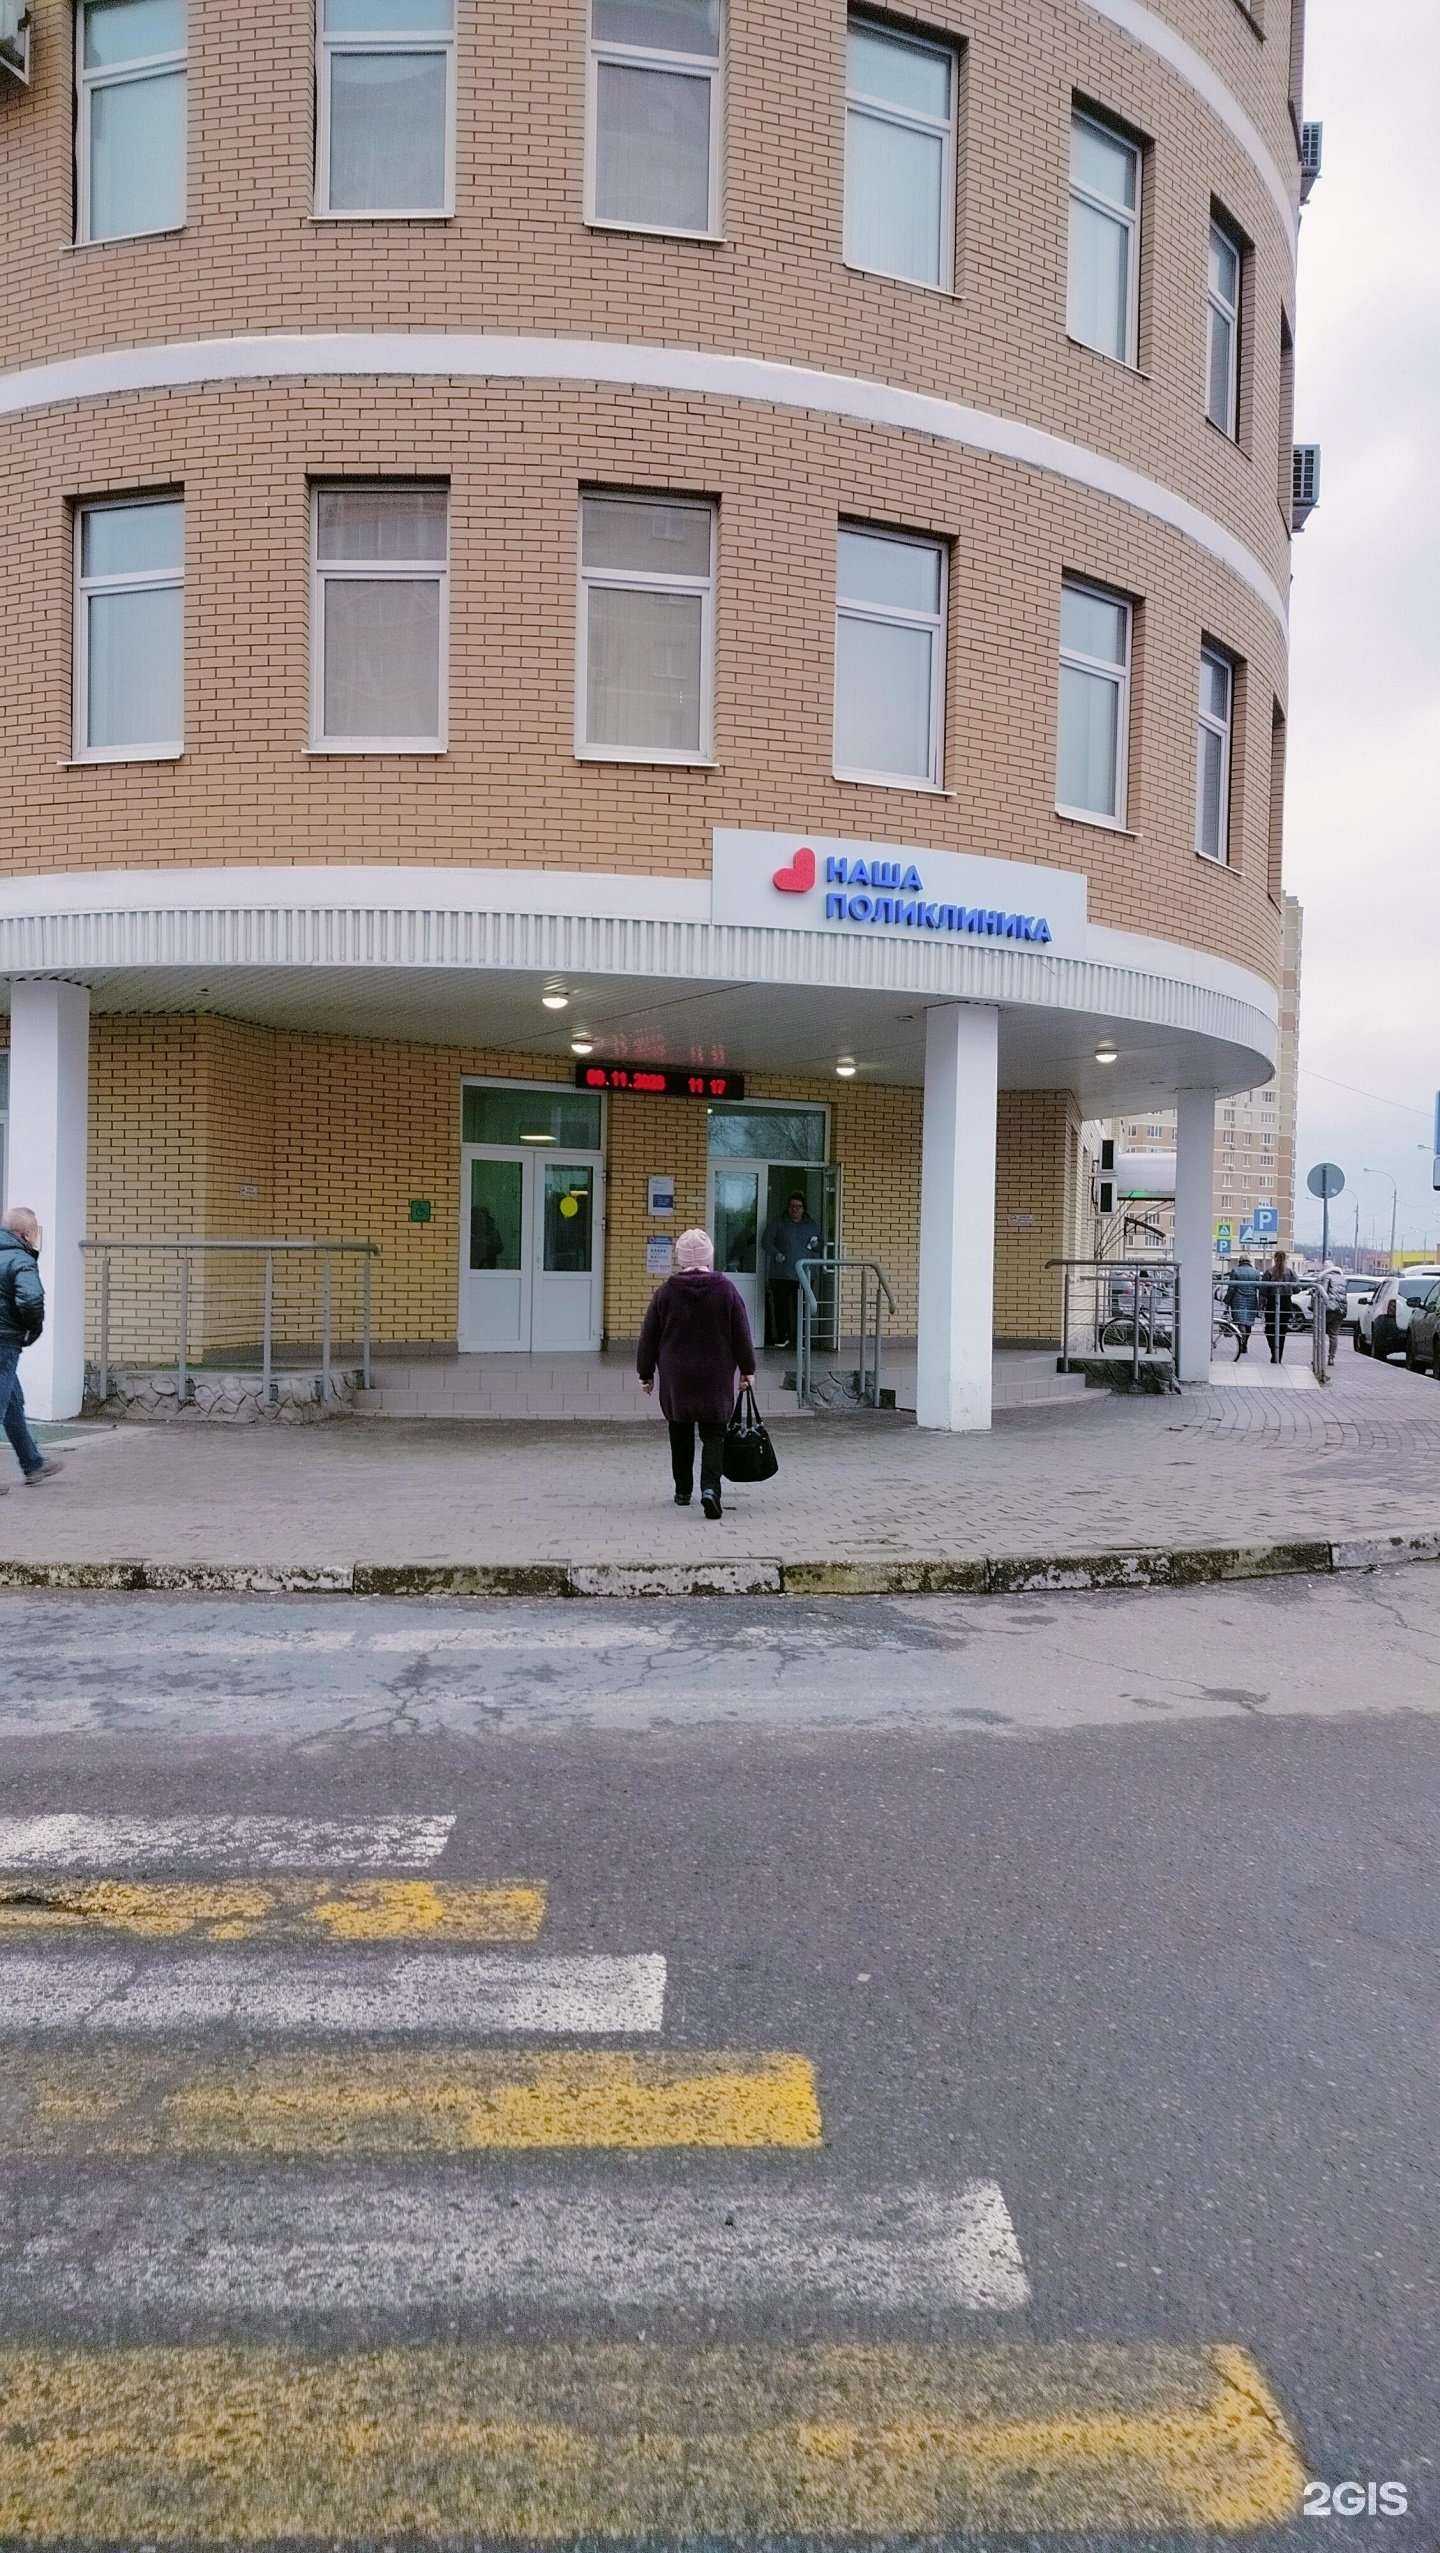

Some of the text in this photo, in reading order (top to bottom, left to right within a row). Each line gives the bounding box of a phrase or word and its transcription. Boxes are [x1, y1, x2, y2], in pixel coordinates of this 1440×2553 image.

[826, 855, 923, 891] НАША
[825, 892, 1052, 943] ПОЛИКЛИНИКА
[1259, 1211, 1272, 1230] P
